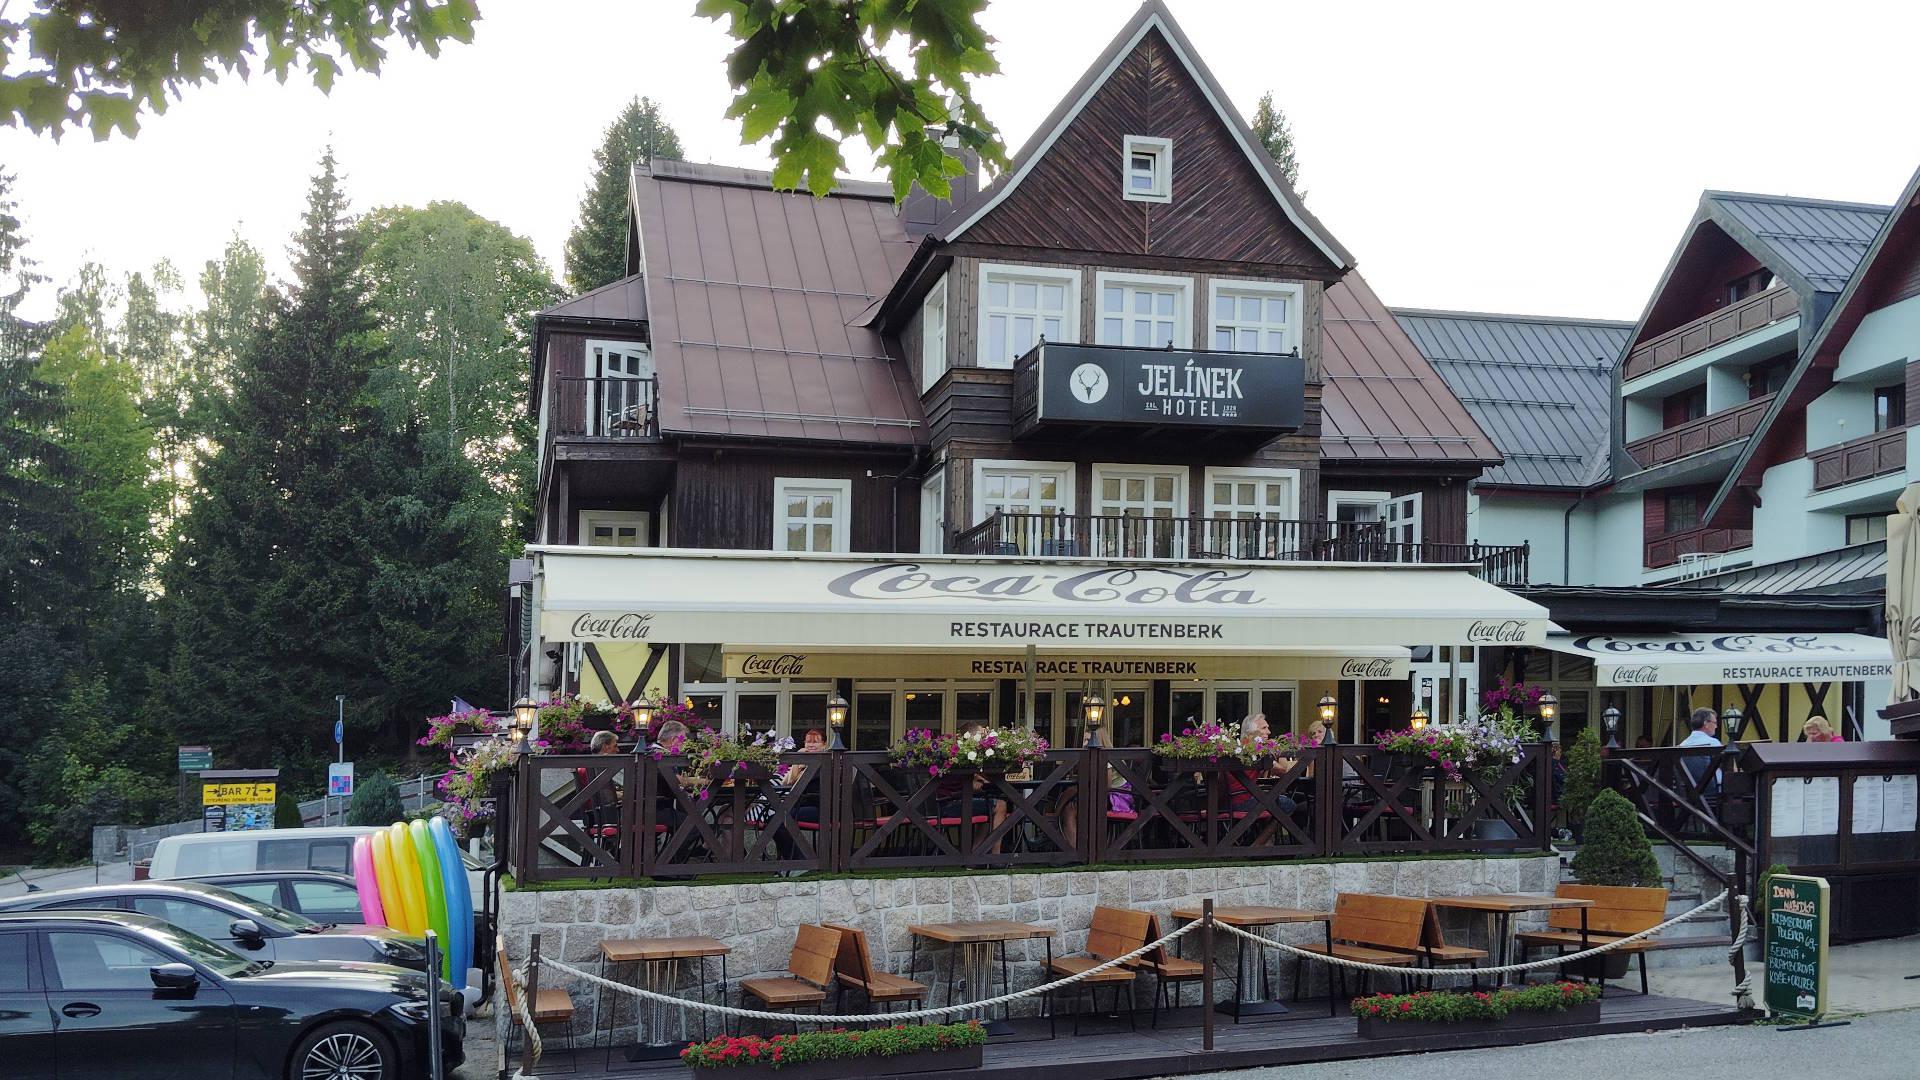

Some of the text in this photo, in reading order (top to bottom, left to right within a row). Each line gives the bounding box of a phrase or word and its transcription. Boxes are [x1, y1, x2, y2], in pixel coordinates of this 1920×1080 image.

[1138, 358, 1244, 399] JELÍNEK
[1162, 398, 1220, 417] HOTEL
[827, 563, 1267, 604] Coca-Cola
[571, 612, 656, 639] Coca-Cola
[950, 622, 1223, 639] RESTAURACE TRAUTENBERK
[1466, 620, 1529, 643] Coca-Cola
[741, 654, 808, 676] Coca-Cola
[971, 660, 1197, 675] RESTARACE TRAUTENBERK
[1340, 658, 1396, 677] Coca-Cola
[1612, 665, 1660, 684] Coca-Cola
[1722, 664, 1893, 679] RESTAURACE TRAUTENBERK
[221, 787, 242, 796] BAR
